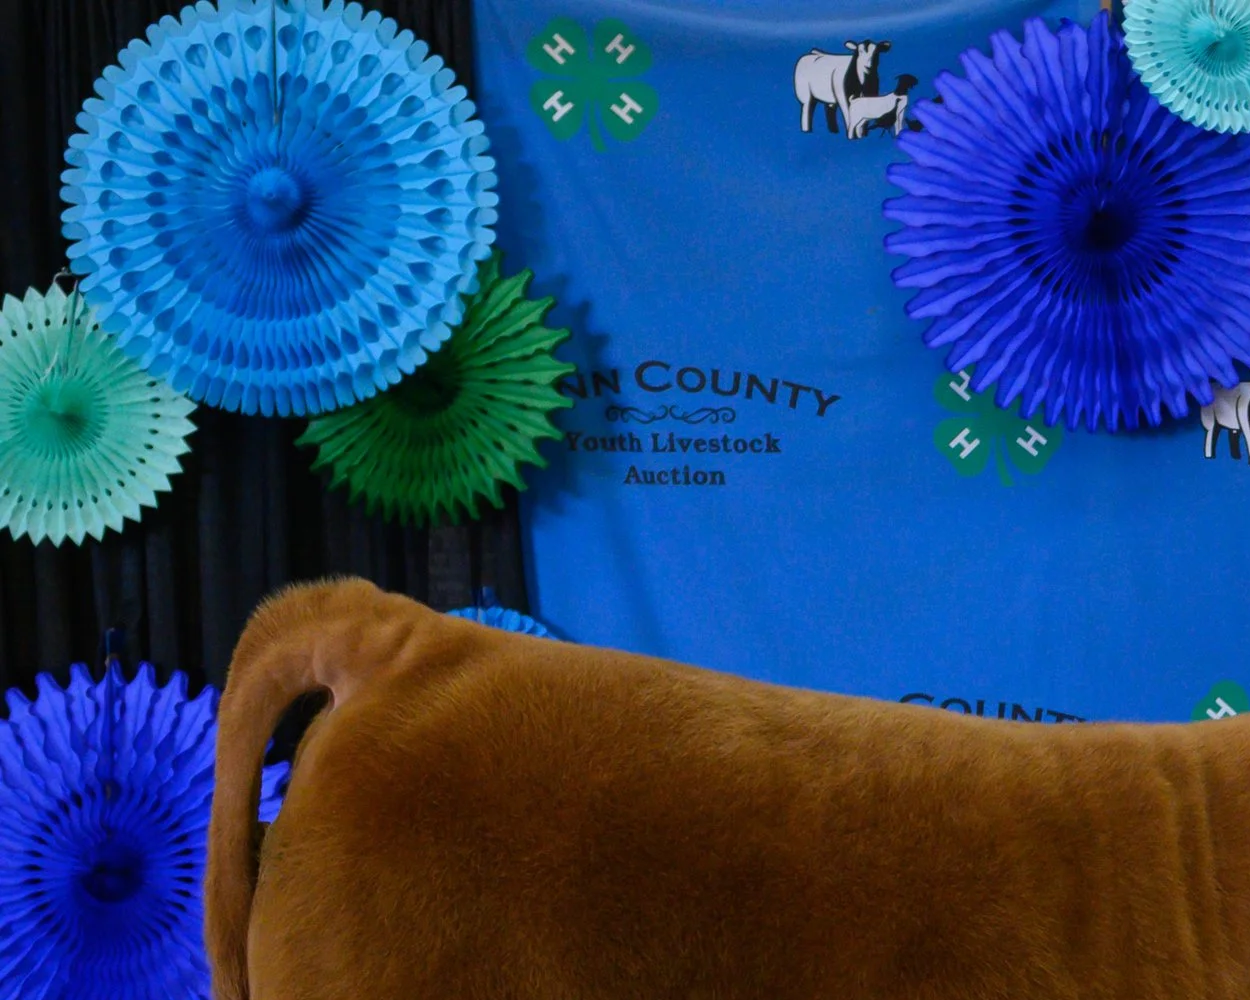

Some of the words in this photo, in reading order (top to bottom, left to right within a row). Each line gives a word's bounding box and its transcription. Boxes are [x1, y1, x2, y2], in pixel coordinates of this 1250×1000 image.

[634, 360, 841, 417] COUNTY
[566, 431, 643, 453] Youth
[651, 432, 782, 453] Livestock
[624, 465, 726, 486] Auction
